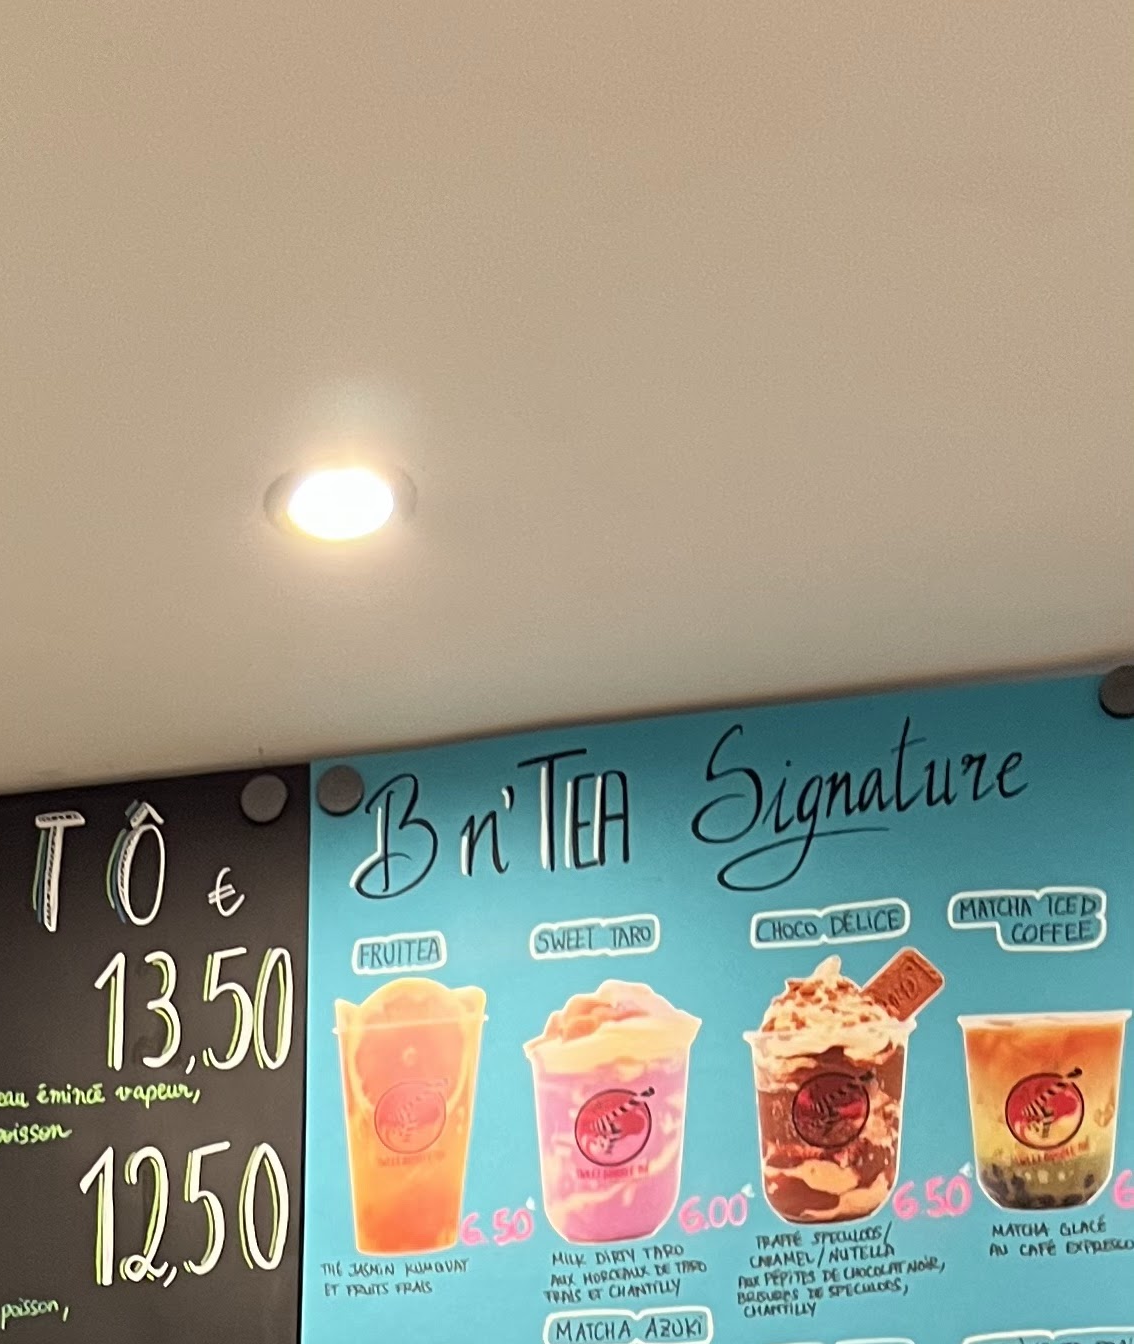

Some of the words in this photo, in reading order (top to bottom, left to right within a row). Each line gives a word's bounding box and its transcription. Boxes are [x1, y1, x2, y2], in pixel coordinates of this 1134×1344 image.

[691, 716, 1029, 892] Signature
[206, 867, 246, 917] €
[960, 897, 1032, 920] MATCHA
[1046, 895, 1099, 917] ICED
[535, 928, 594, 954] SWEET
[610, 926, 652, 948] TARO
[756, 919, 817, 943] CHOCO
[830, 909, 900, 935] DÉLICE
[1012, 922, 1094, 943] COFFEE
[357, 937, 441, 969] FRUITEA
[93, 946, 297, 1076] 13,50
[555, 1318, 631, 1343] MATCHA
